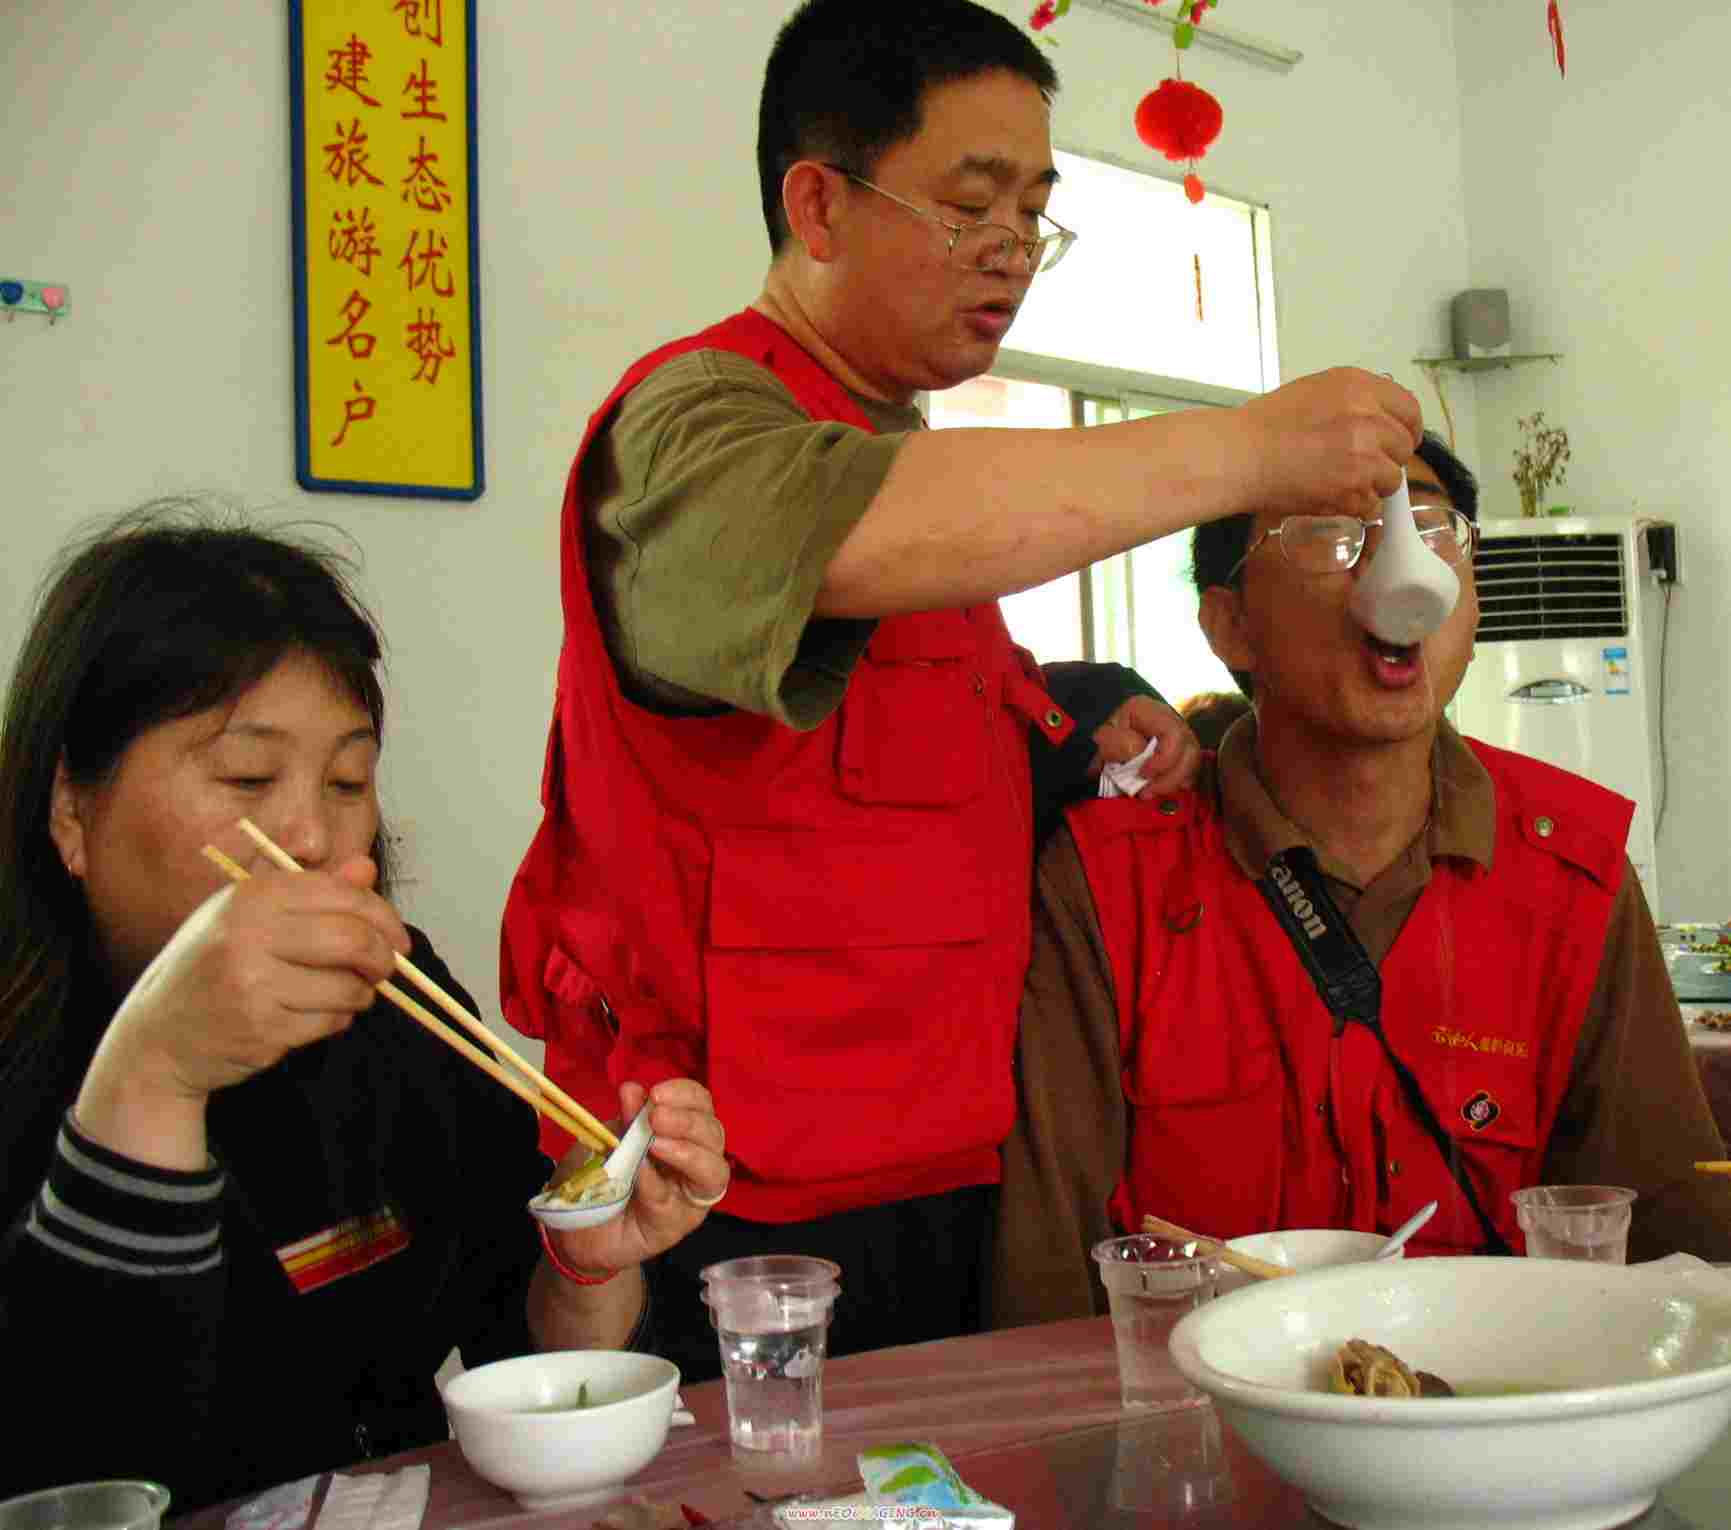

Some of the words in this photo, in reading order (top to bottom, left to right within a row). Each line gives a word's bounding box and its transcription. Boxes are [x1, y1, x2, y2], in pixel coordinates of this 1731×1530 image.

[324, 33, 384, 447] 建旅游名户
[393, 0, 455, 385] 创生态优势
[1271, 862, 1328, 940] anon
